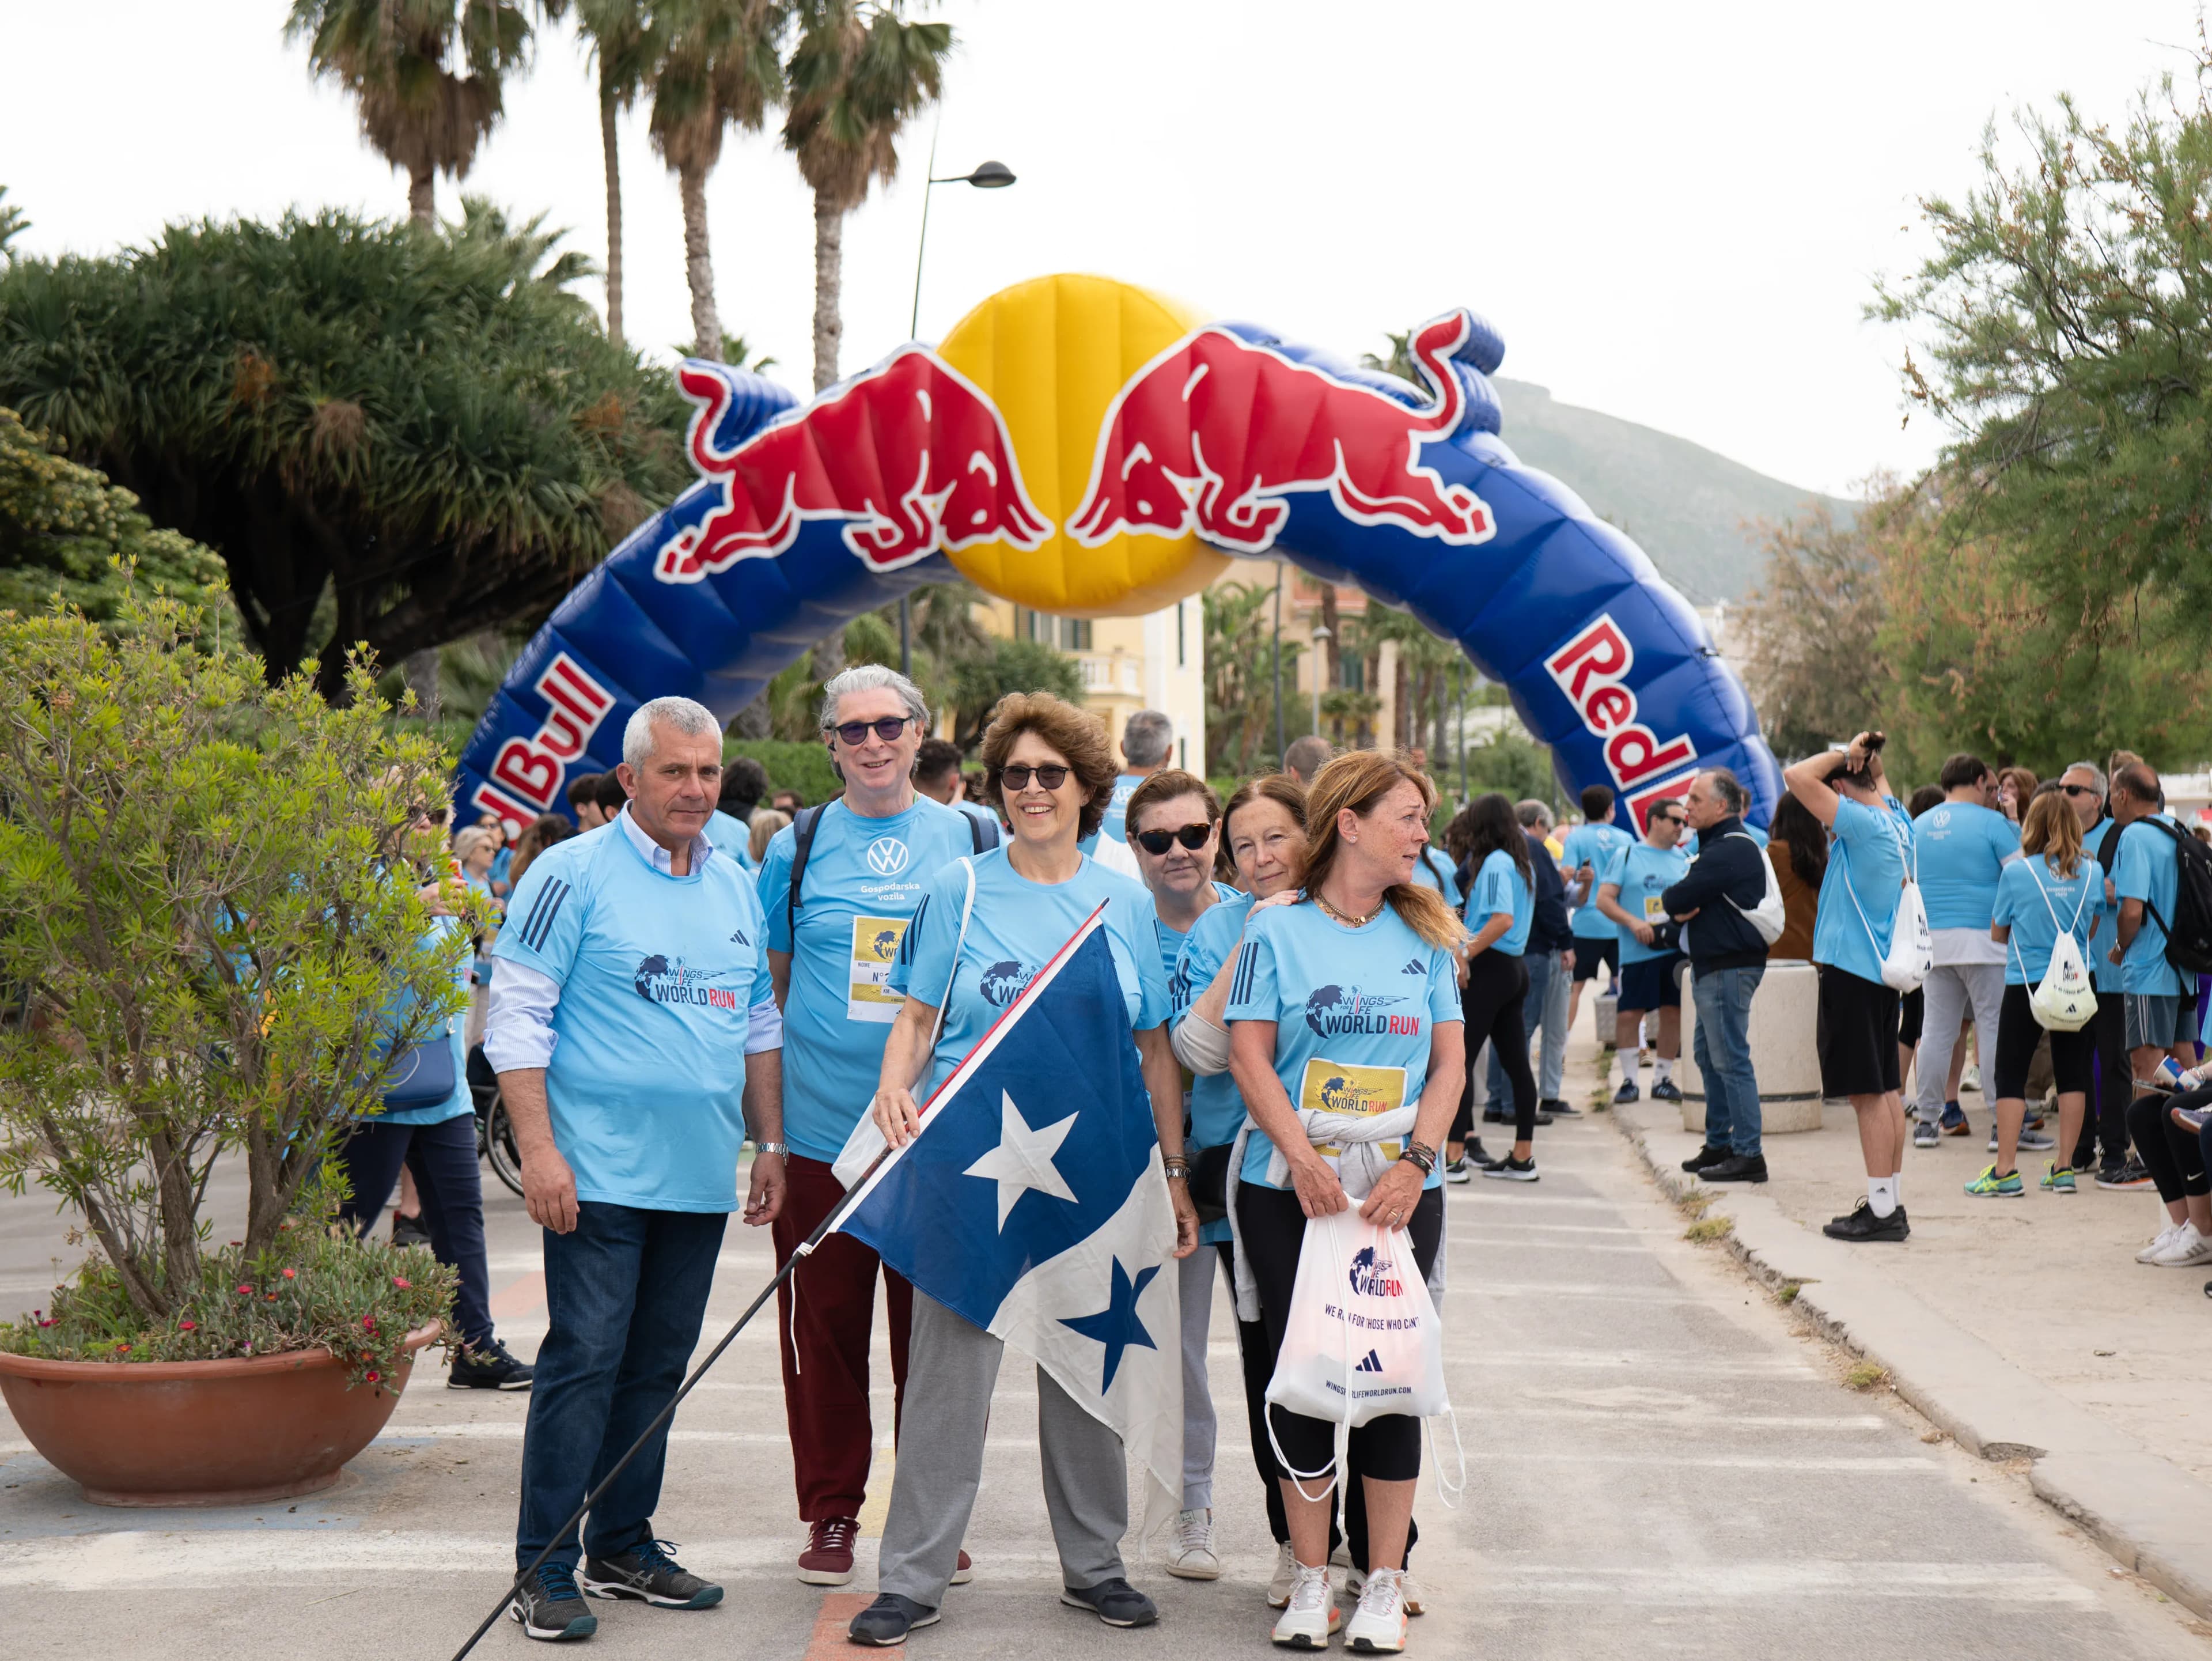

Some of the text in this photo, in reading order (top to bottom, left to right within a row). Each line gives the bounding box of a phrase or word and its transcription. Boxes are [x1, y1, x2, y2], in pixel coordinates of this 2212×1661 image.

[1547, 618, 1694, 787] Red
[492, 656, 612, 807] Bull
[861, 882, 920, 894] Gospodarska
[878, 892, 905, 902] vozila
[669, 966, 703, 979] WINGS
[674, 977, 694, 986] LIFE
[656, 984, 735, 1009] WORLD RUN
[1342, 995, 1385, 1005] WINGS
[1348, 1005, 1373, 1015] LIFE
[1326, 1015, 1419, 1036] WORLD RUN
[1343, 1086, 1369, 1094] WINGS
[1332, 1096, 1387, 1113] WORLD RUN
[1386, 1279, 1403, 1297] RUN
[1325, 1303, 1336, 1317] WE
[1352, 1314, 1365, 1328] FOR
[1387, 1319, 1402, 1330] WHO
